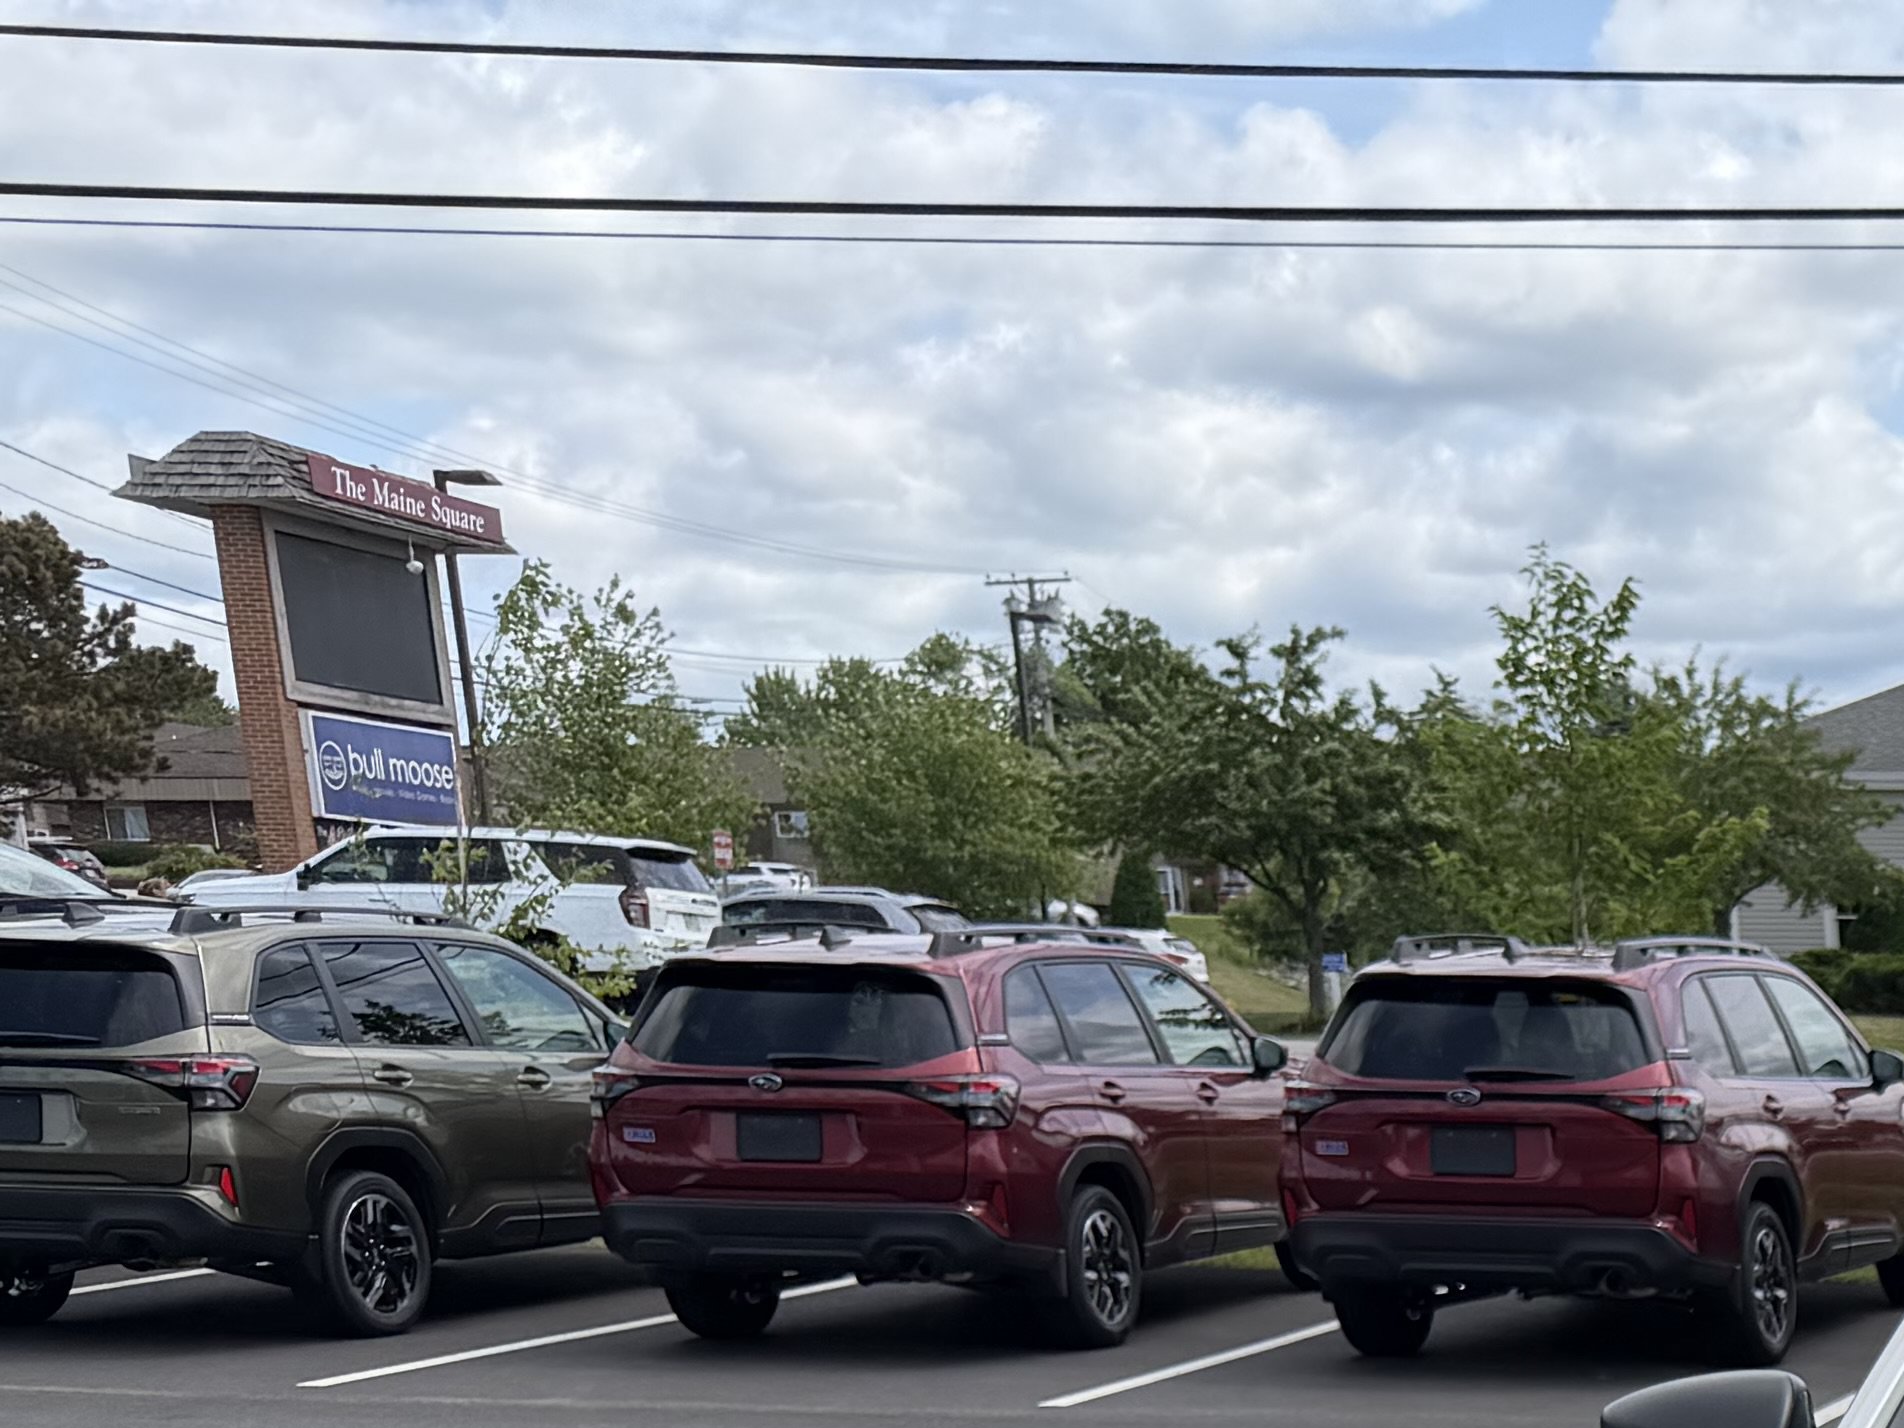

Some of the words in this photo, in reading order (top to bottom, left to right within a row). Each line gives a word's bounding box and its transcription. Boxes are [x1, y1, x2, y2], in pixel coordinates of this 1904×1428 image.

[331, 465, 366, 501] The
[371, 477, 426, 518] Maine
[431, 495, 485, 533] Square
[347, 743, 386, 781] bull
[389, 757, 454, 790] moose
